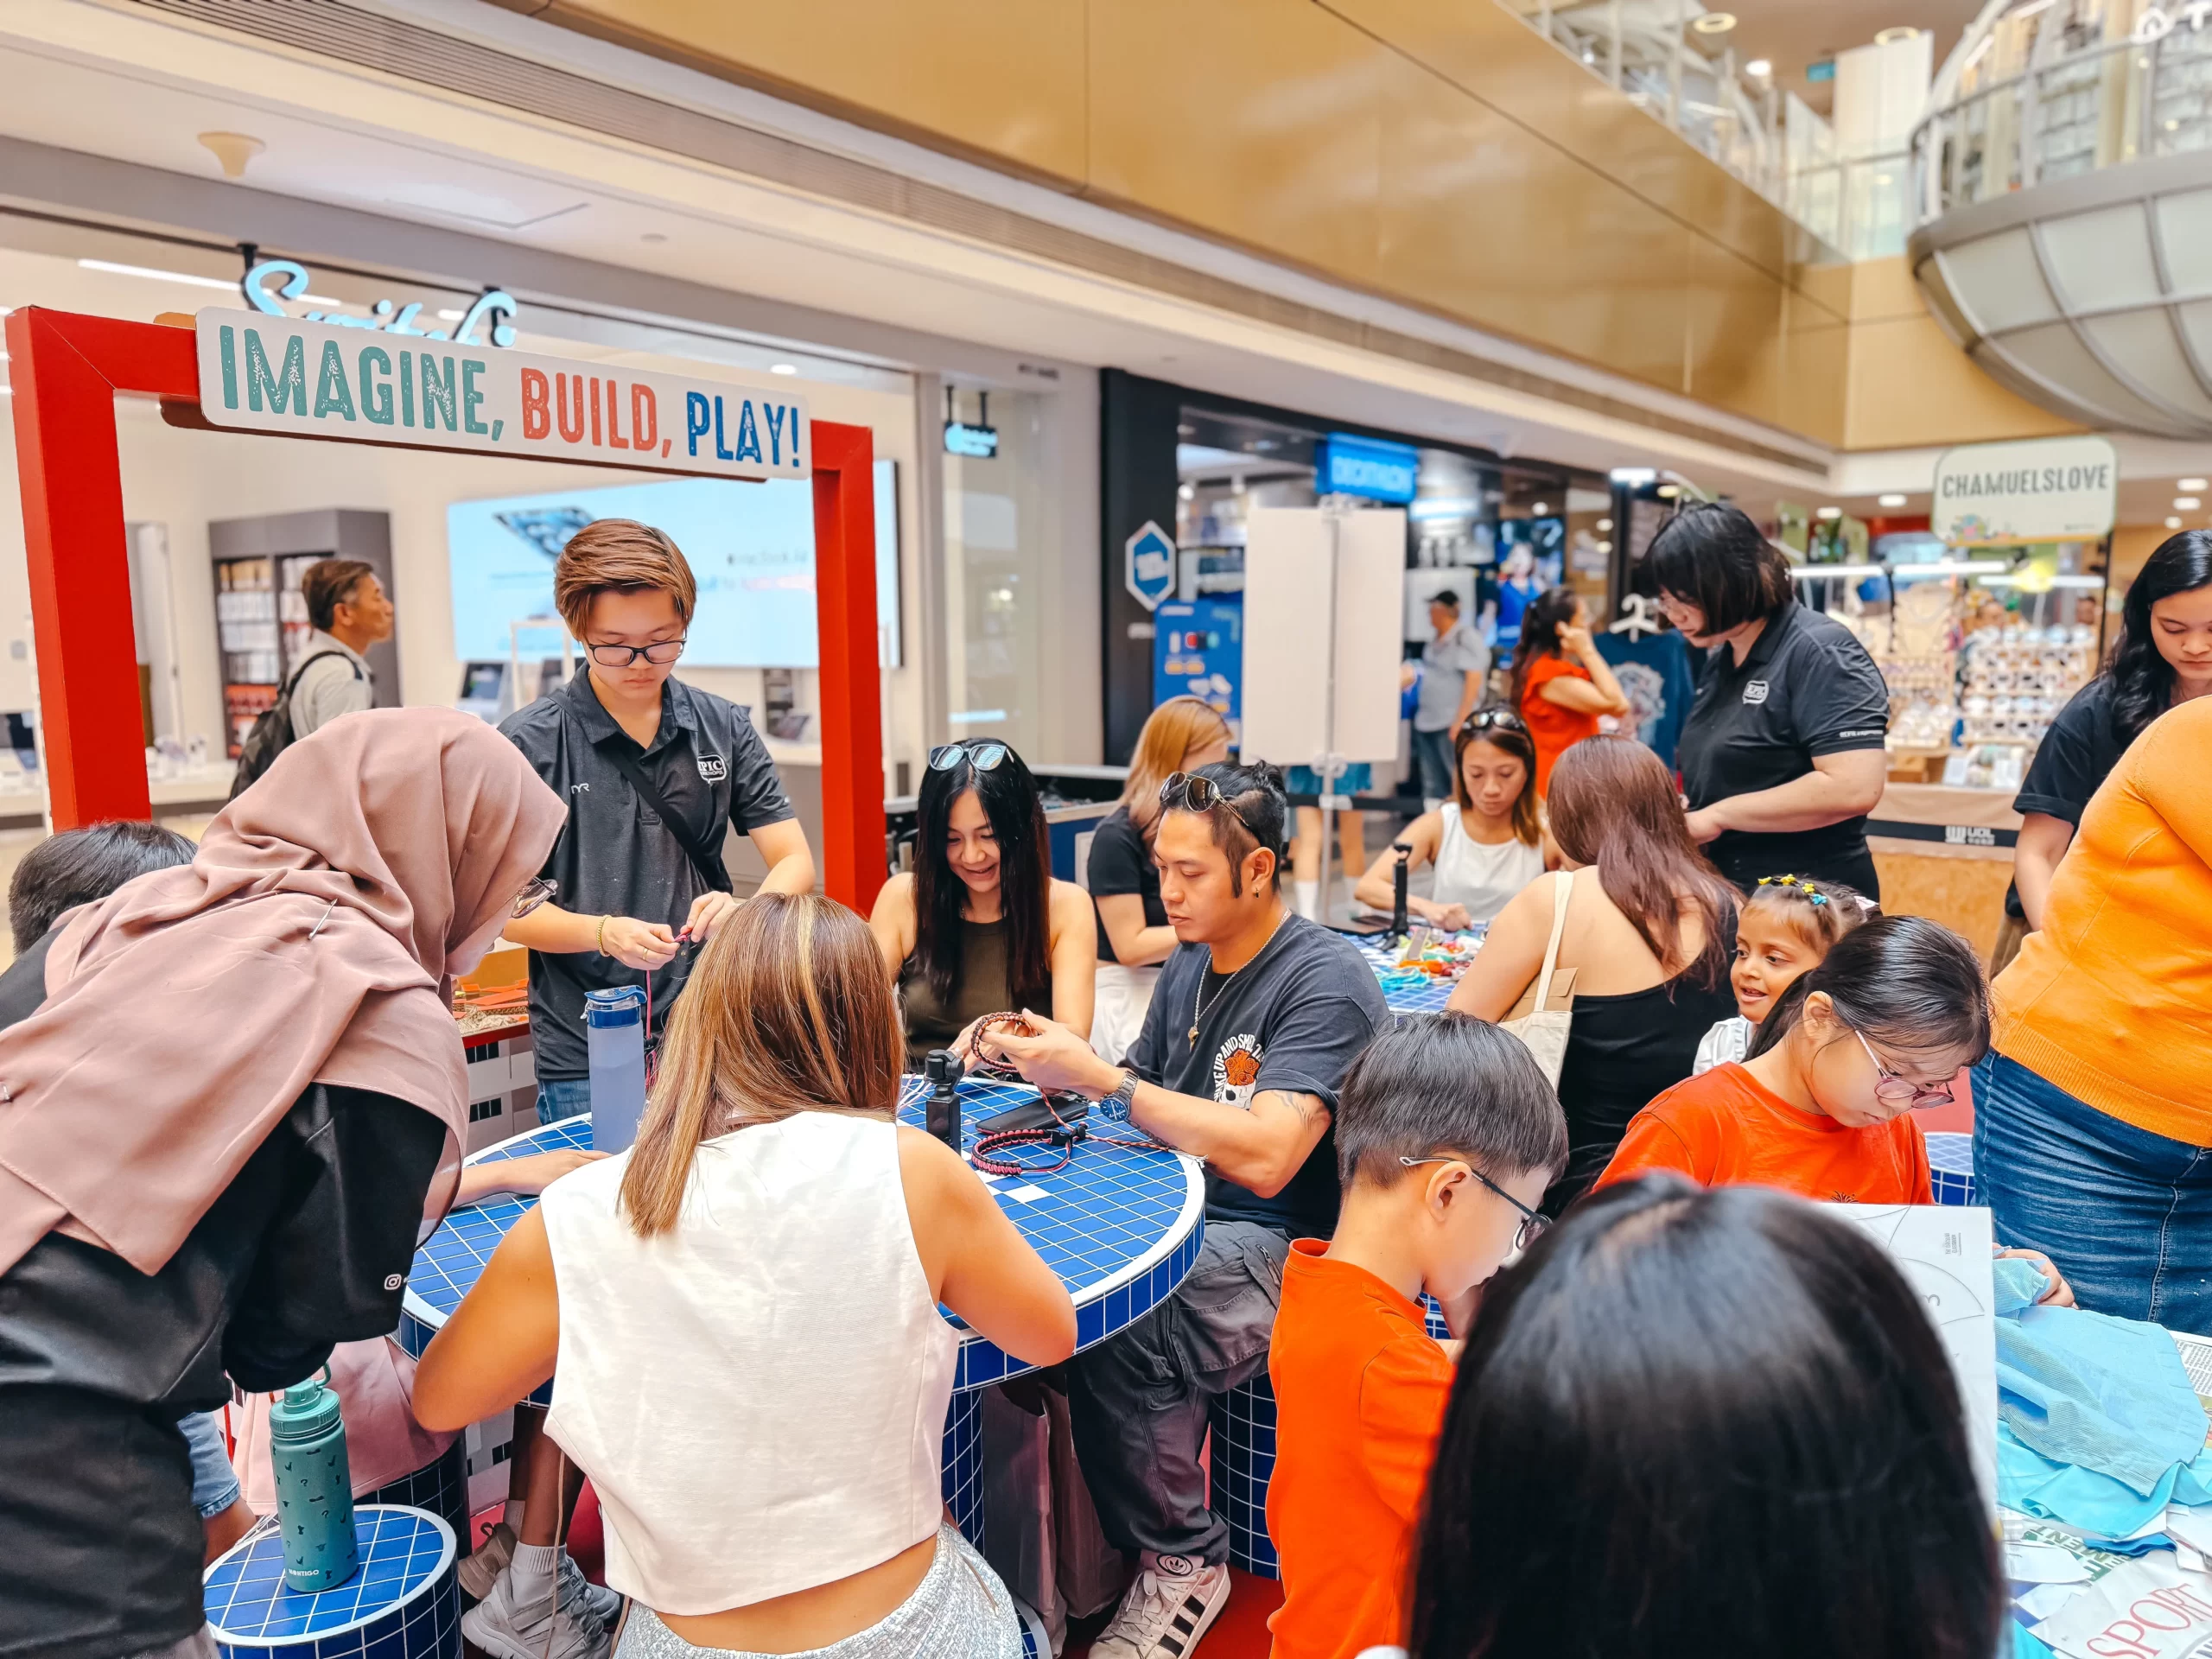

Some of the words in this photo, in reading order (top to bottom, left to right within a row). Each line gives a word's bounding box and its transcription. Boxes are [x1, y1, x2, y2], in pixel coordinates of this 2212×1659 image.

[219, 325, 505, 442] IMAGINE,
[520, 367, 672, 459] BUILD,
[687, 391, 800, 467] PLAY!
[1942, 463, 2110, 499] CHAMUELSLOVE
[1213, 1052, 1226, 1071] UP
[1220, 1036, 1239, 1059] AND
